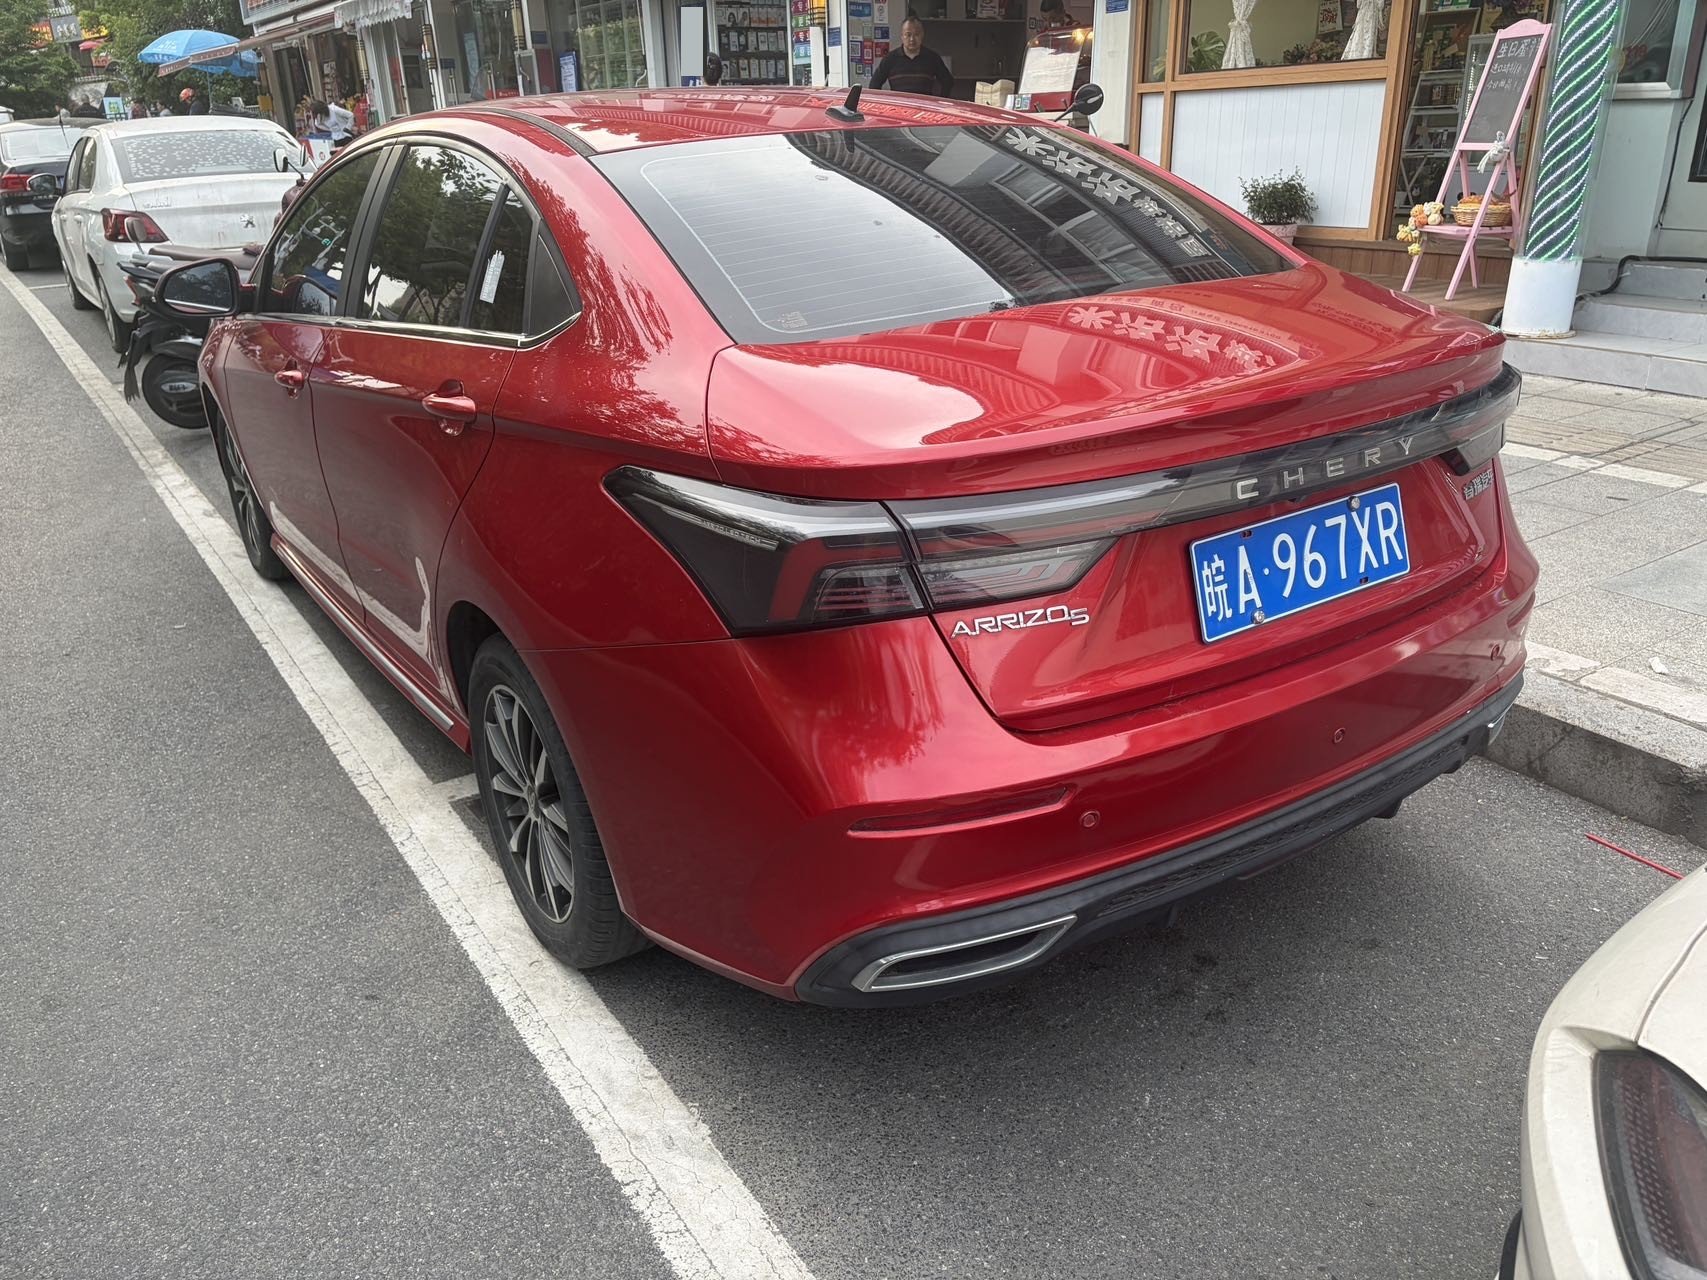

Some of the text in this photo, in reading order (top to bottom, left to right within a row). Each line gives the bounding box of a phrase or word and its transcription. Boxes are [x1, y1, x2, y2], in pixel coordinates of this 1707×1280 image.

[1236, 437, 1413, 500] CHERY
[1201, 501, 1404, 622] 皖A·967XR
[951, 605, 1090, 639] ARRIZO5
